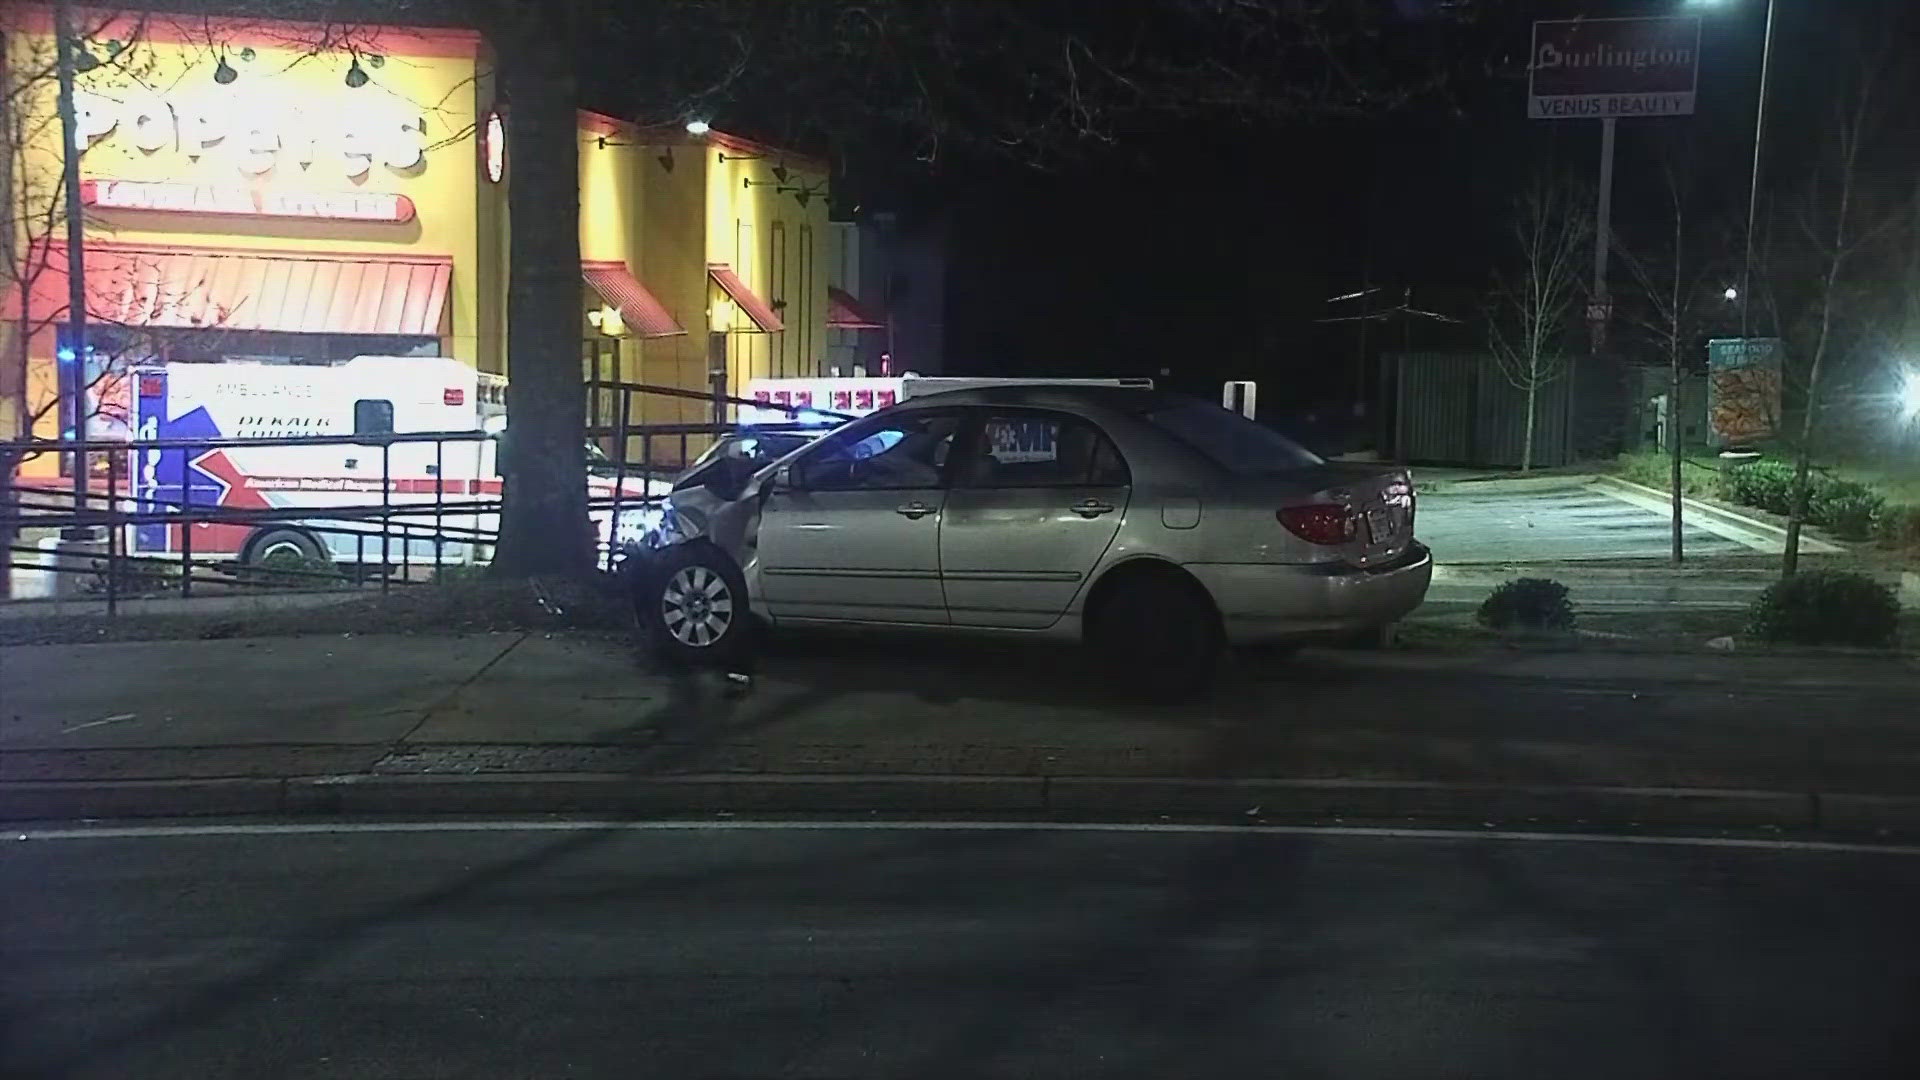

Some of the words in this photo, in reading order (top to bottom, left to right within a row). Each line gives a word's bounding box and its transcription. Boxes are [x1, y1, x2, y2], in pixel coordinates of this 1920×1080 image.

[1538, 43, 1692, 73] Burlington
[1540, 98, 1601, 116] VENUS
[1607, 97, 1682, 113] BEAUTY
[73, 92, 427, 177] POPEYES
